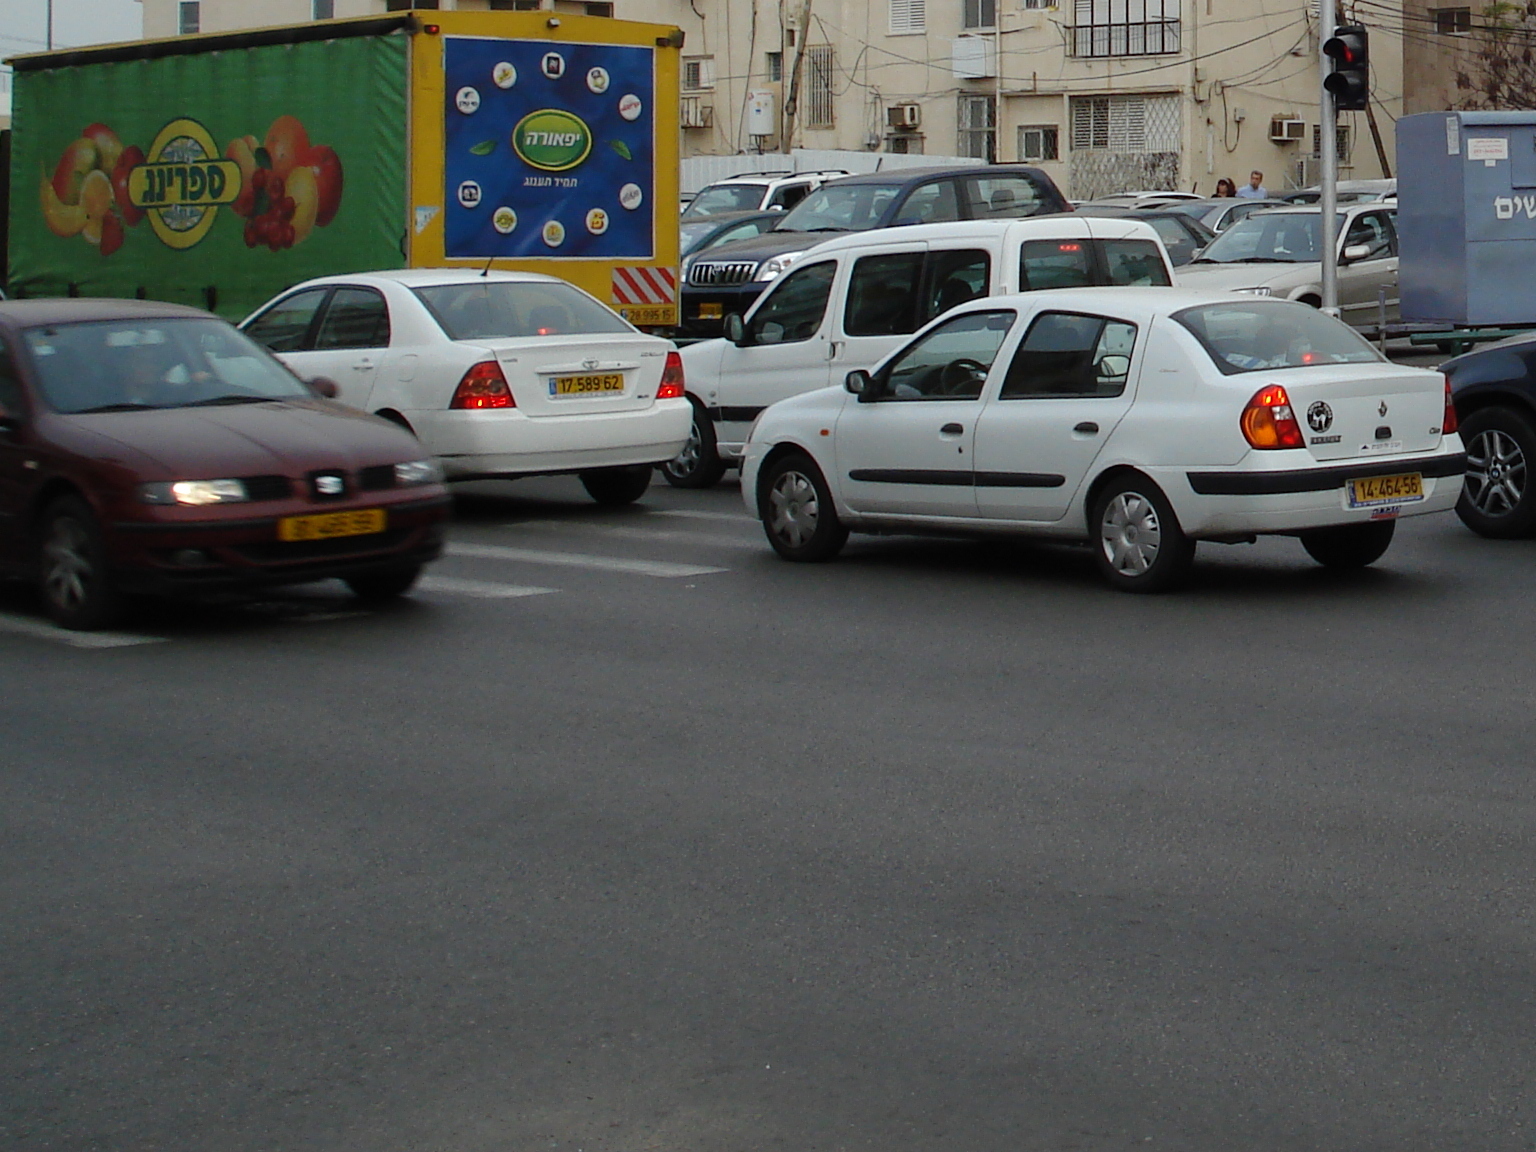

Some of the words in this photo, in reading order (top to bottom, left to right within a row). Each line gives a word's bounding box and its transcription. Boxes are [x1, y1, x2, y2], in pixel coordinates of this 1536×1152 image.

[525, 132, 581, 147] יפאורה
[142, 164, 226, 203] ספרינג
[523, 177, 552, 187] תענוג
[554, 177, 578, 188] תמיד
